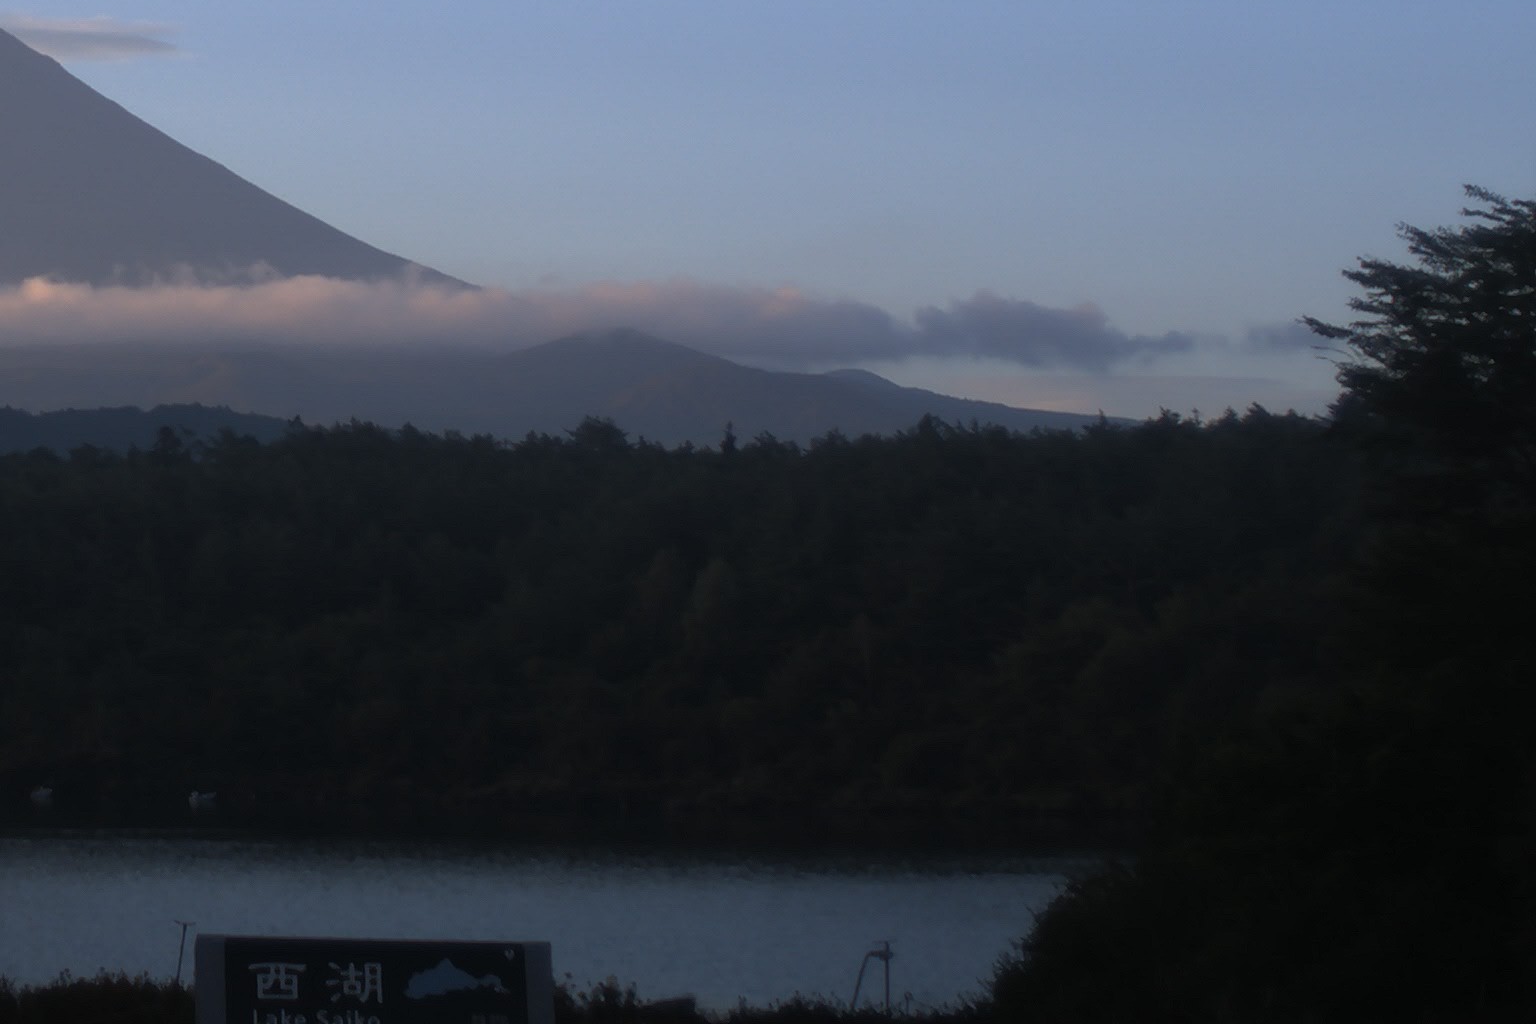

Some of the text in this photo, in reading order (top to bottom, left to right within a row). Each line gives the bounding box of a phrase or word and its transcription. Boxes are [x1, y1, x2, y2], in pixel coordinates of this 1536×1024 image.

[248, 962, 383, 1003] 西湖
[252, 1009, 382, 1024] Lake Saiko
